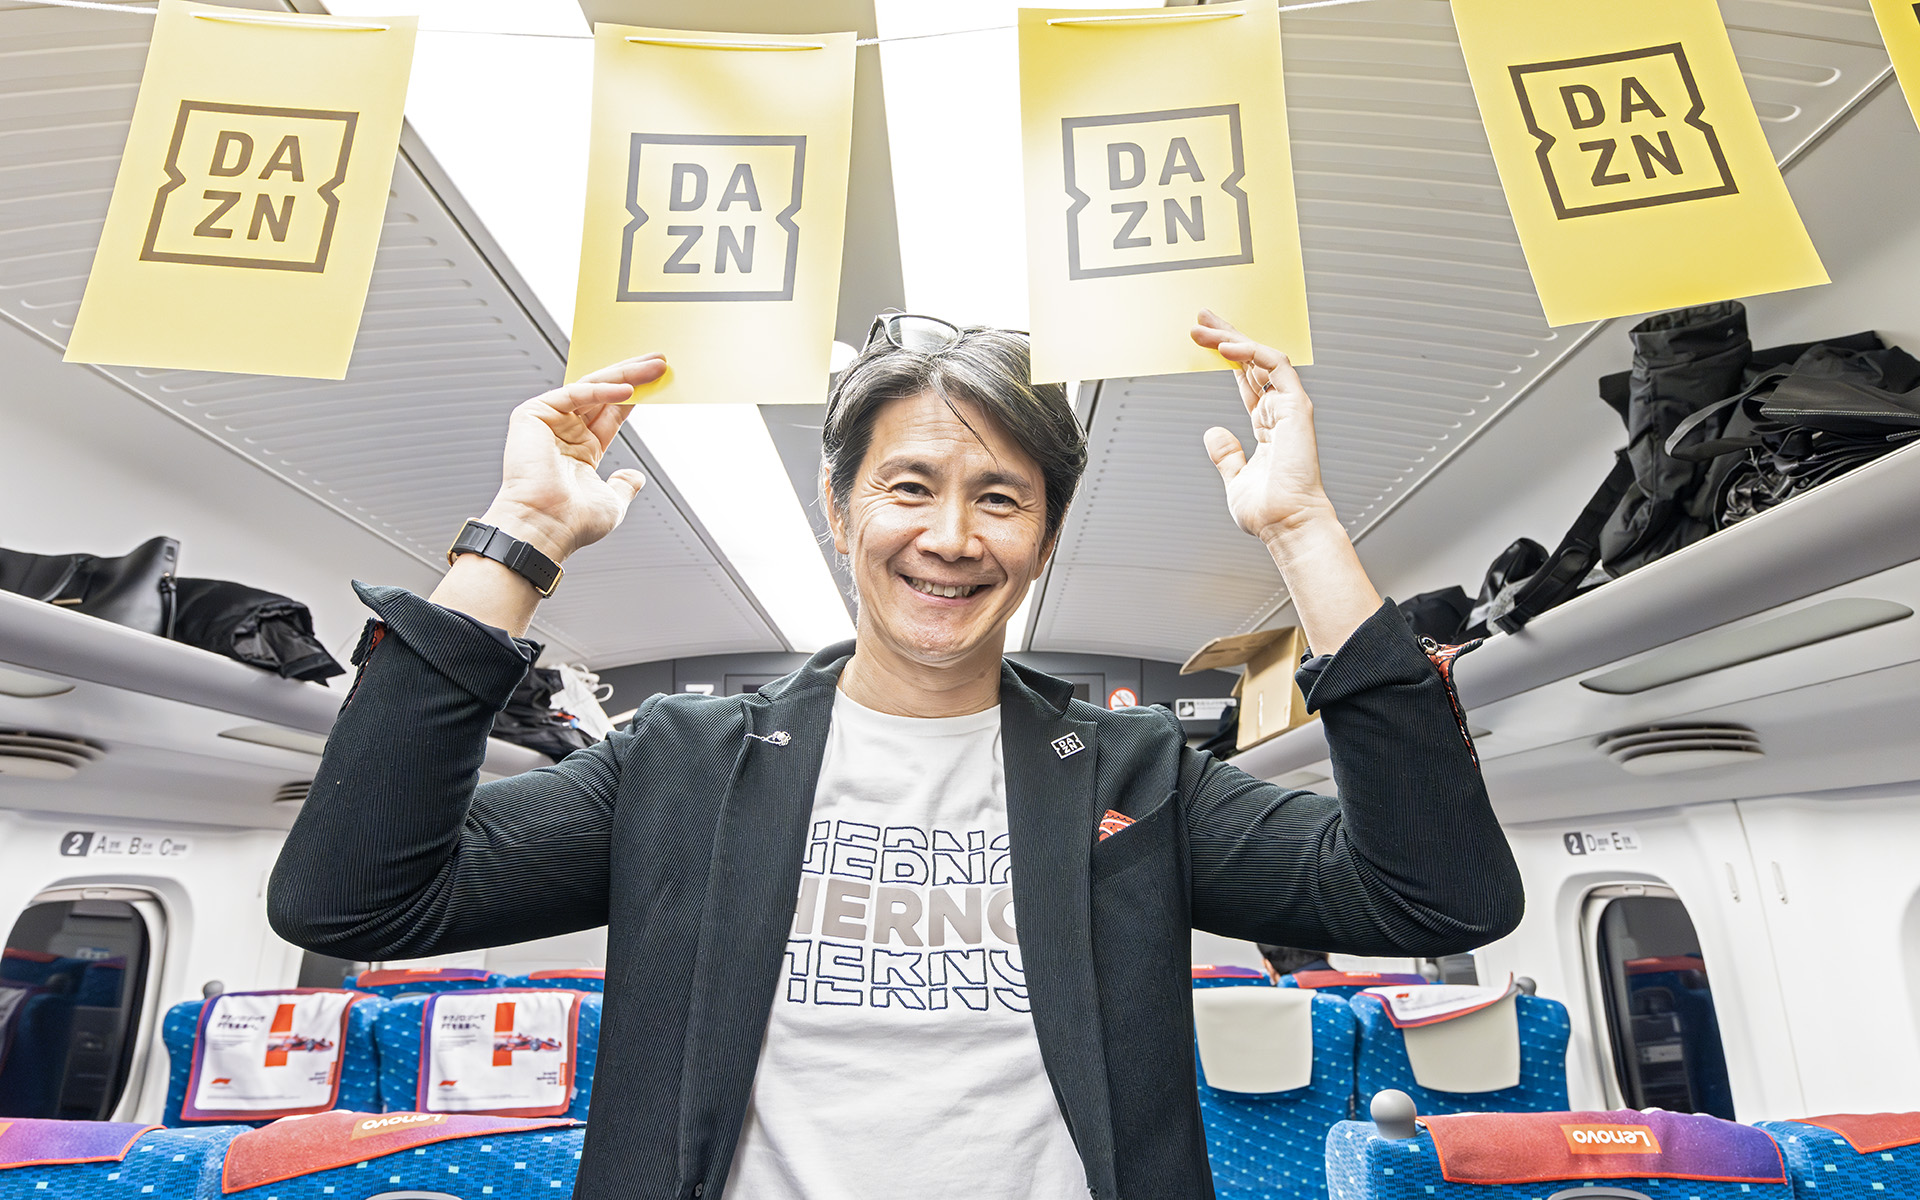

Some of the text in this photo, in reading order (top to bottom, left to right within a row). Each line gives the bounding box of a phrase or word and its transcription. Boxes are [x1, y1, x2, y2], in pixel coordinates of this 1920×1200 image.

[1559, 76, 1667, 130] DA
[208, 130, 305, 182] DA
[1107, 136, 1206, 190] DA
[1579, 130, 1684, 187] ZN
[669, 162, 762, 212] DA
[193, 189, 296, 242] ZN
[1110, 195, 1206, 249] ZN
[662, 225, 756, 274] ZN
[67, 833, 84, 855] 2
[93, 835, 107, 854] A
[128, 836, 142, 855] B
[160, 838, 172, 856] C
[1569, 834, 1581, 854] 2
[1585, 834, 1597, 851] D
[1611, 832, 1622, 850] E
[361, 1114, 443, 1130] Lenovo
[1572, 1129, 1652, 1147] Lenovo
